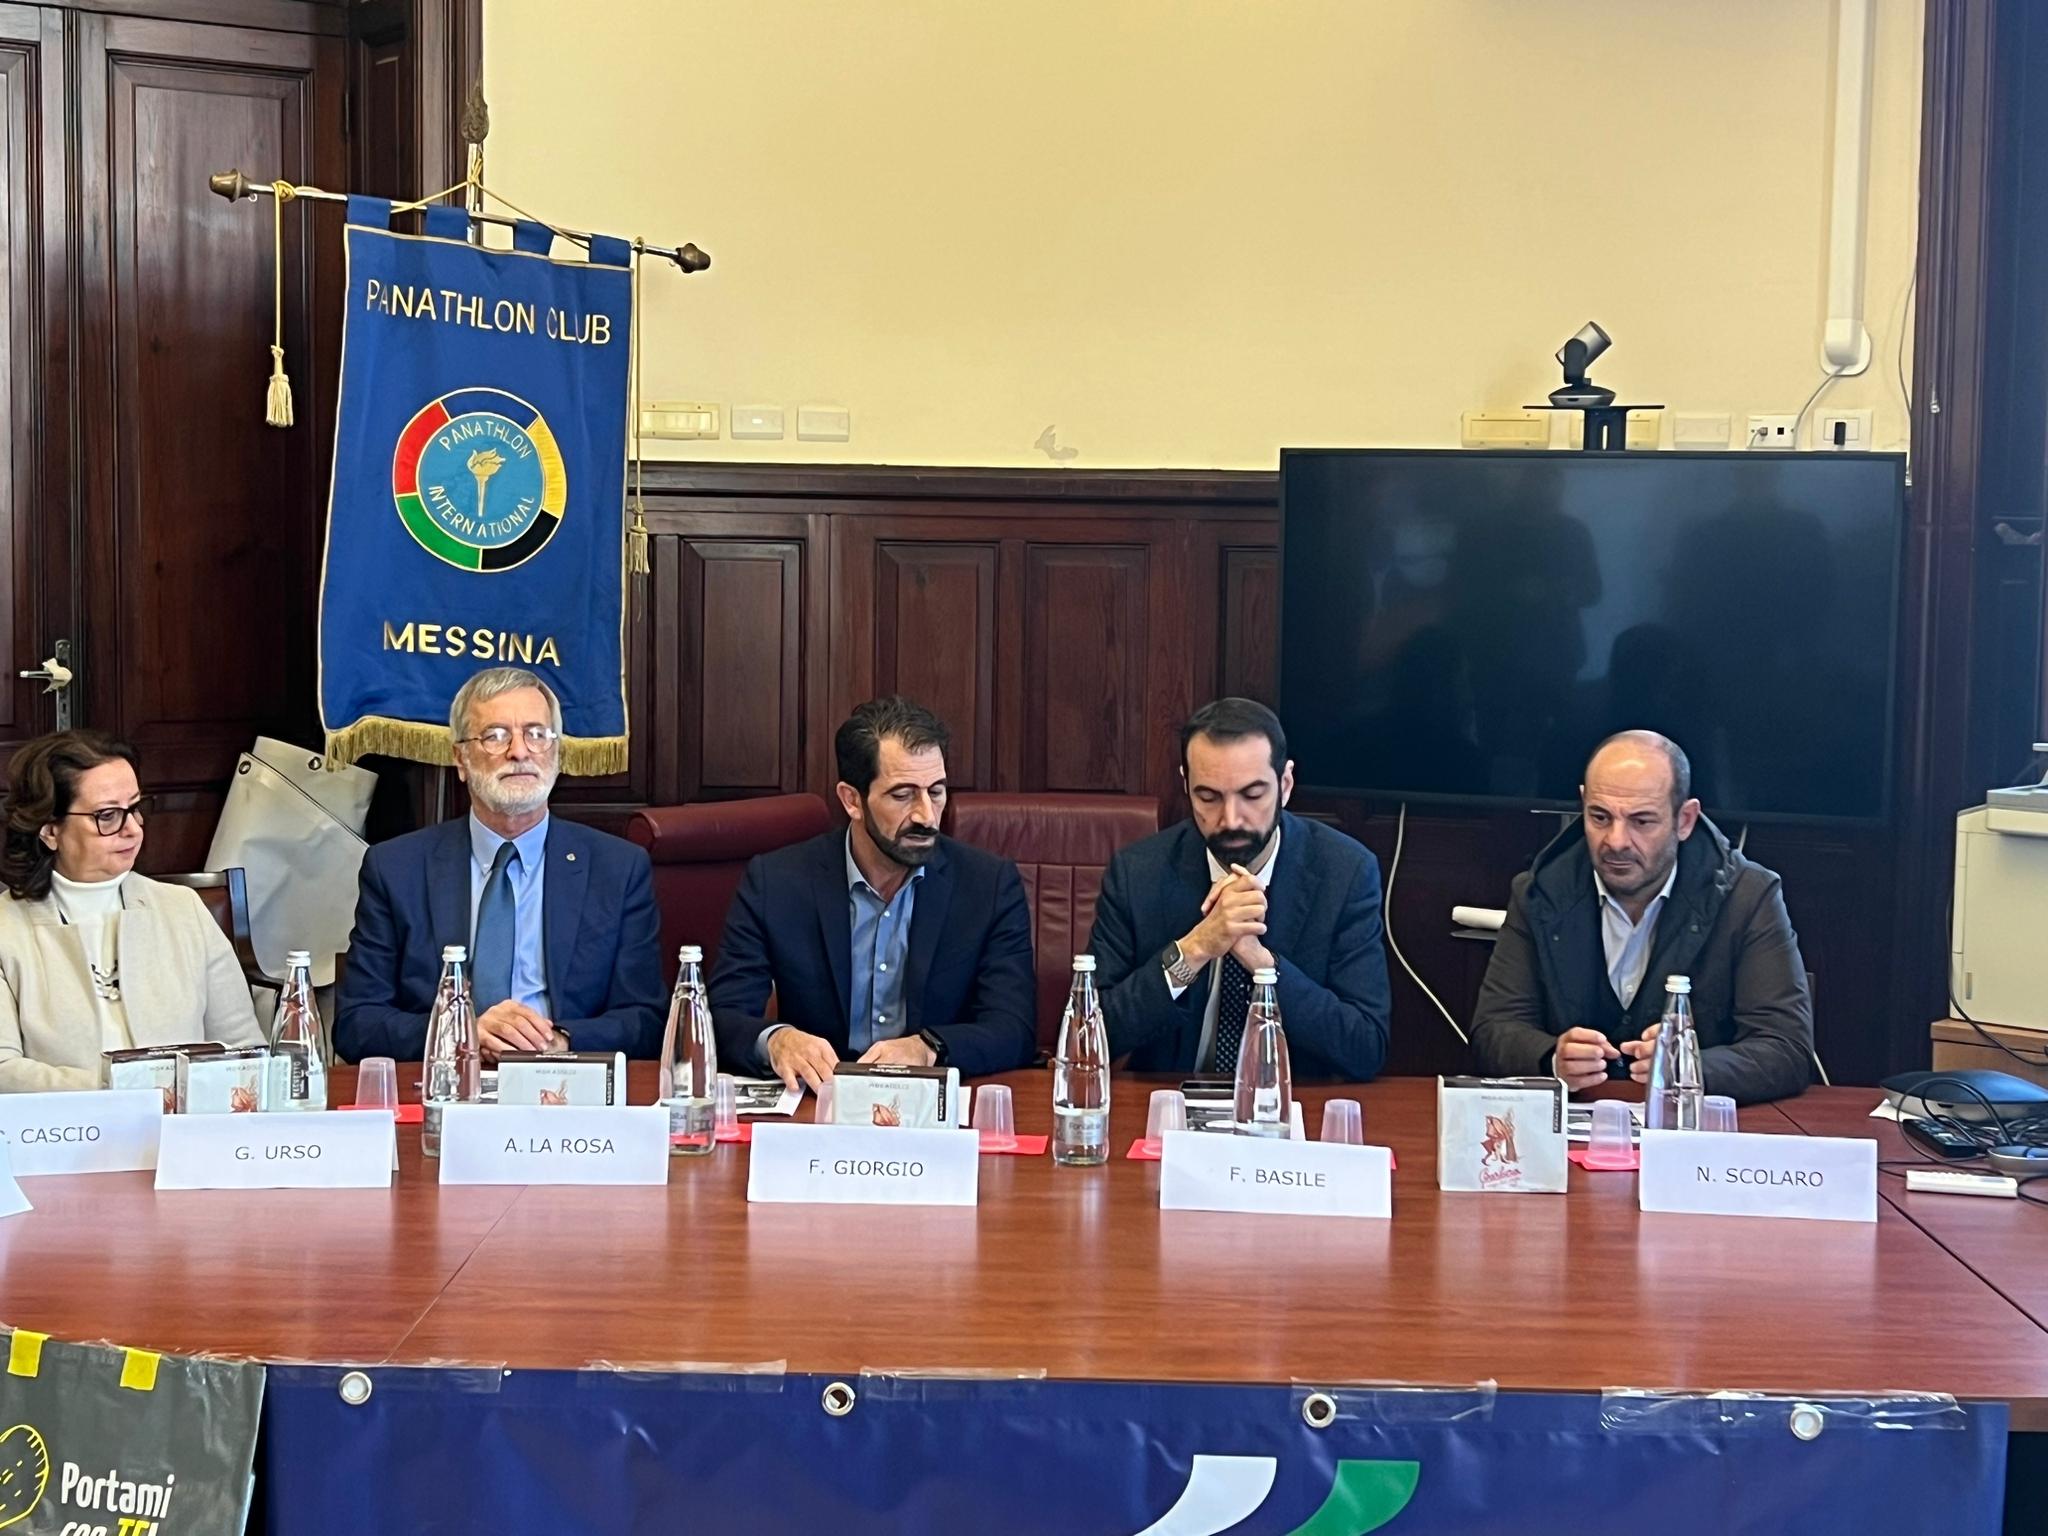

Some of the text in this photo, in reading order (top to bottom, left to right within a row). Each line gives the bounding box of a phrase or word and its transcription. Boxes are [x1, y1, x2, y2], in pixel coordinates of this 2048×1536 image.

[366, 279, 611, 345] PANATHLON CLUB
[438, 420, 532, 459] PANATHLON
[428, 485, 535, 538] INTERNATIONAL
[384, 620, 561, 667] MESSINA
[20, 1125, 101, 1144] CASCIO
[504, 1137, 615, 1154] A. LA ROSA
[234, 1144, 322, 1161] G. URSO
[809, 1158, 924, 1178] F. GIORGIO
[1230, 1166, 1326, 1188] F. BASILE
[1696, 1165, 1824, 1188] N. SCOLARO
[61, 1461, 175, 1518] Portami
